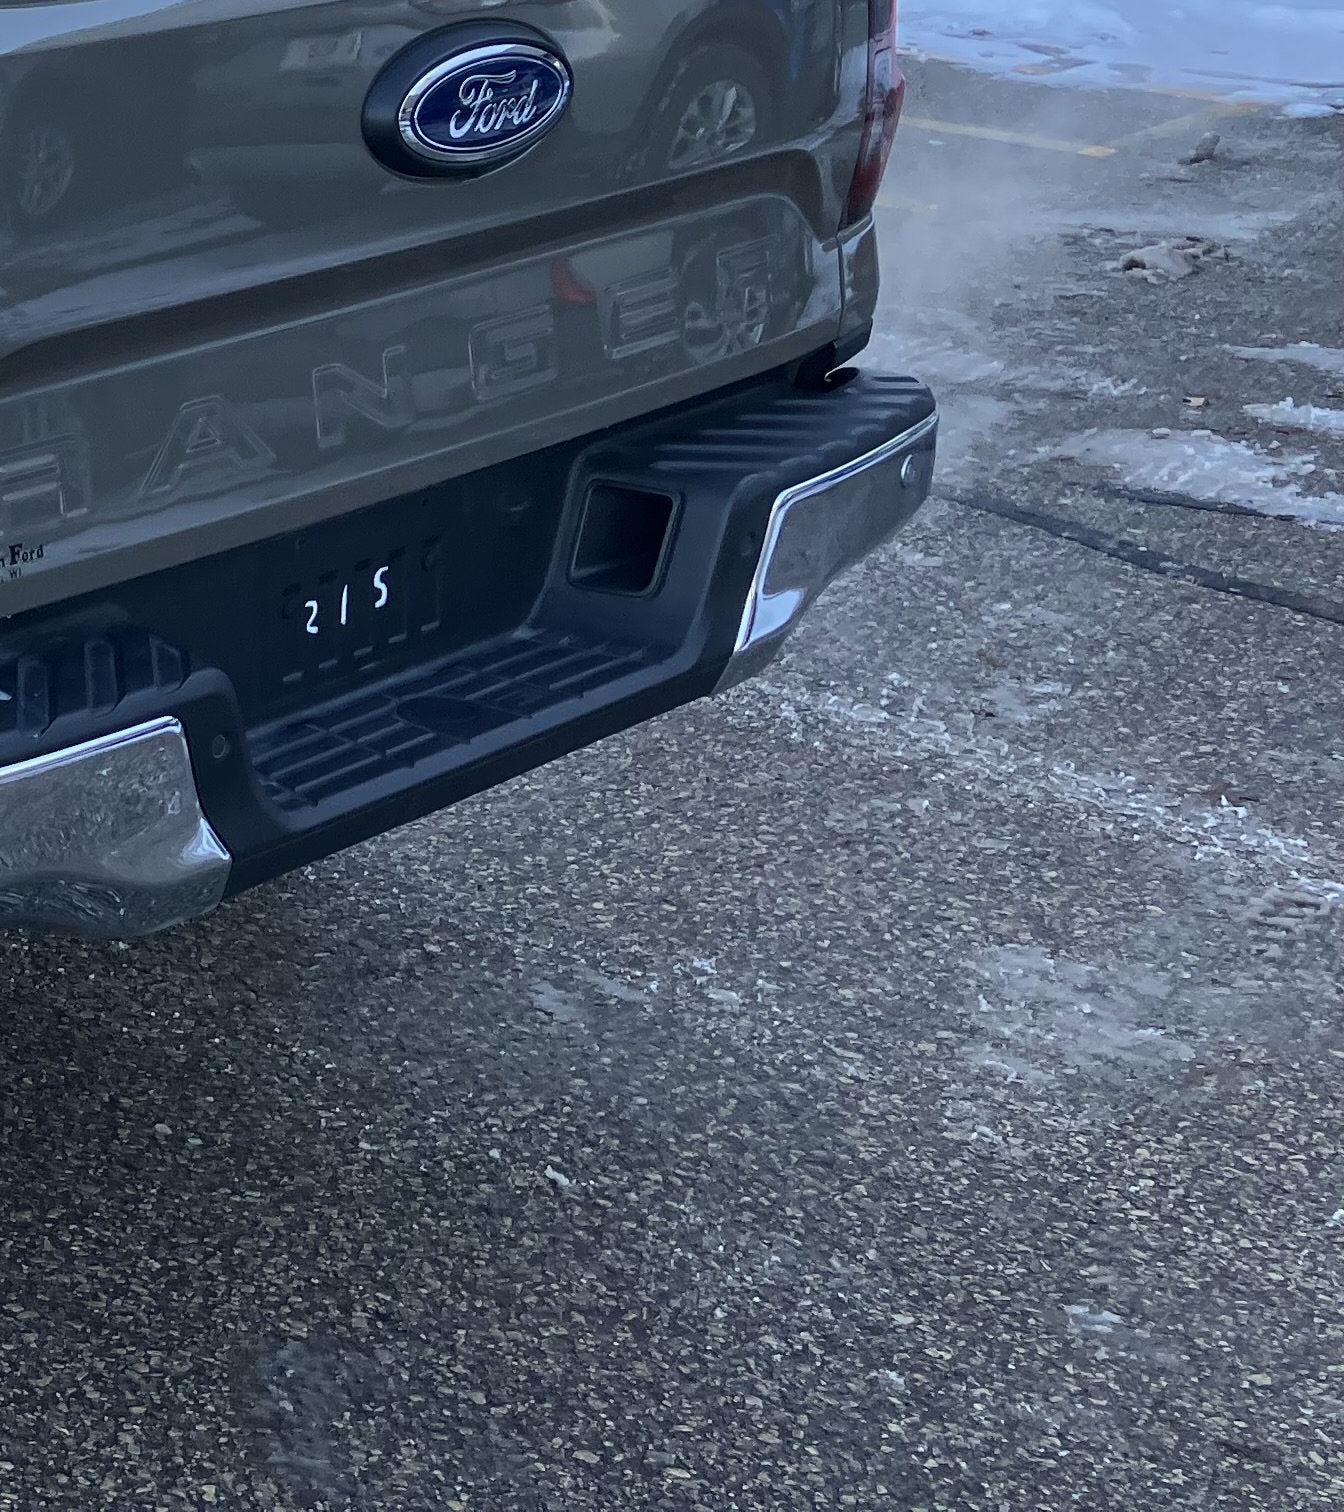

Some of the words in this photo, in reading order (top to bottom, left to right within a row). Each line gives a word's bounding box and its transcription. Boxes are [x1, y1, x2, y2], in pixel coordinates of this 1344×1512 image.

[449, 69, 539, 139] Ford
[8, 543, 45, 567] Ford
[9, 567, 23, 579] WI
